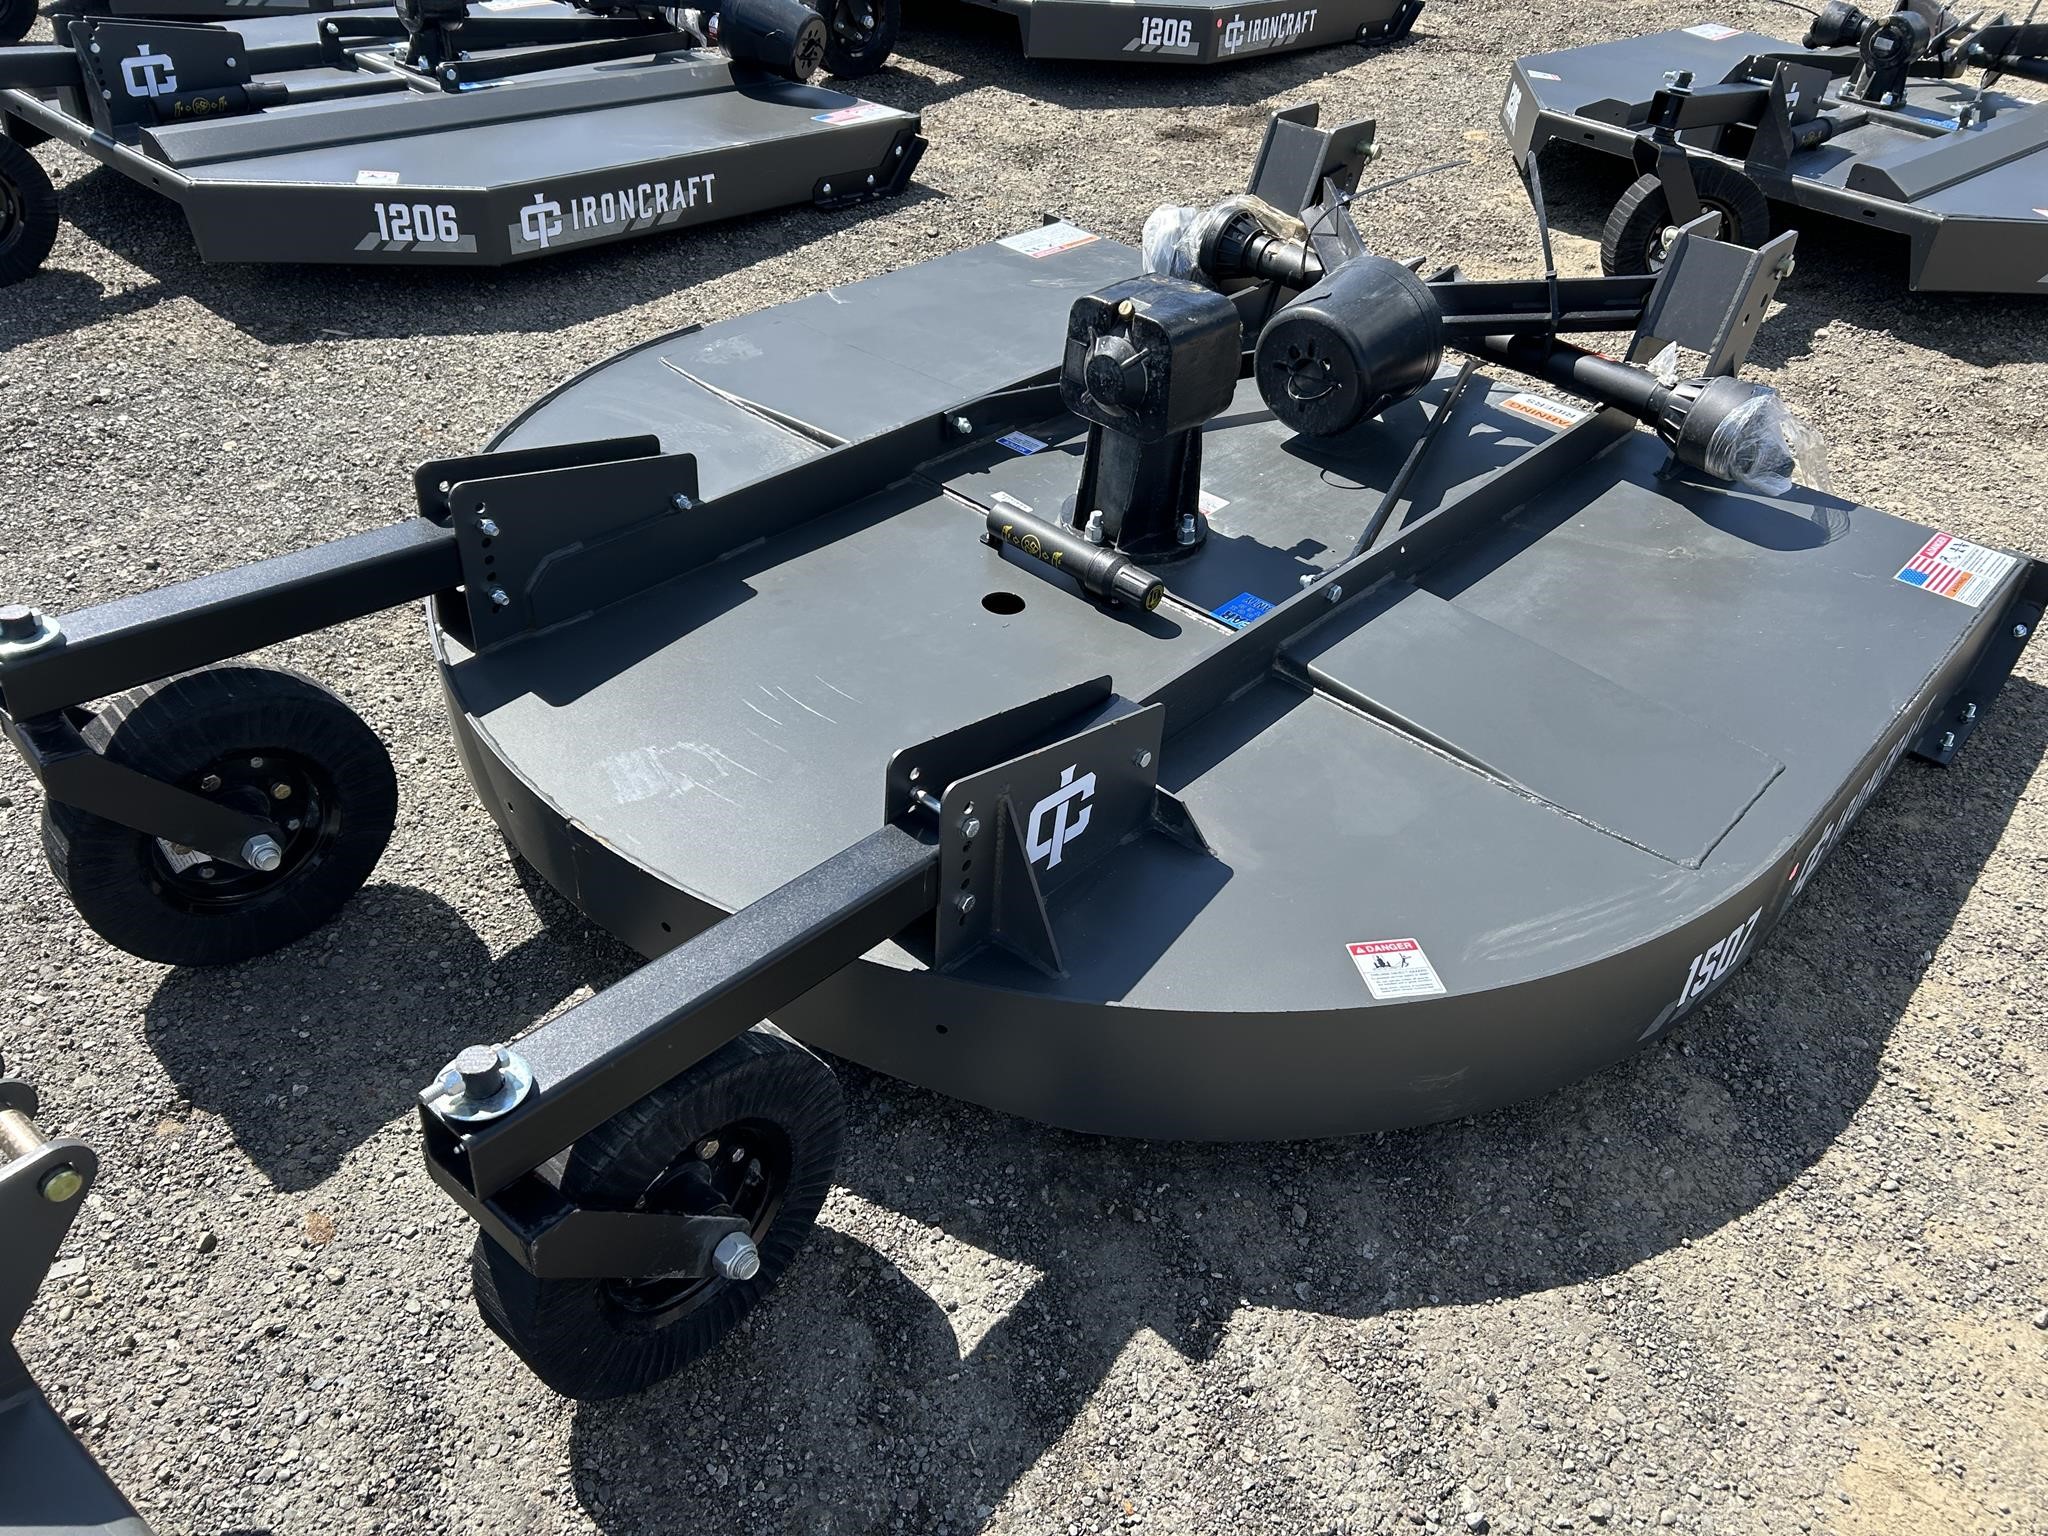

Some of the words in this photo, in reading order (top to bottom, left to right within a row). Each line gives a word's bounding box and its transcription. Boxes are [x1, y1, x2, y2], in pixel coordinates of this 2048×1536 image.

[1141, 16, 1192, 48] 1206
[1247, 9, 1317, 43] IRONCRAFT
[570, 172, 716, 231] IRONCRAFT
[373, 202, 461, 243] 1206
[1526, 398, 1577, 419] RIDERS
[1365, 941, 1413, 953] DANGER
[1676, 905, 1763, 1008] 1507
